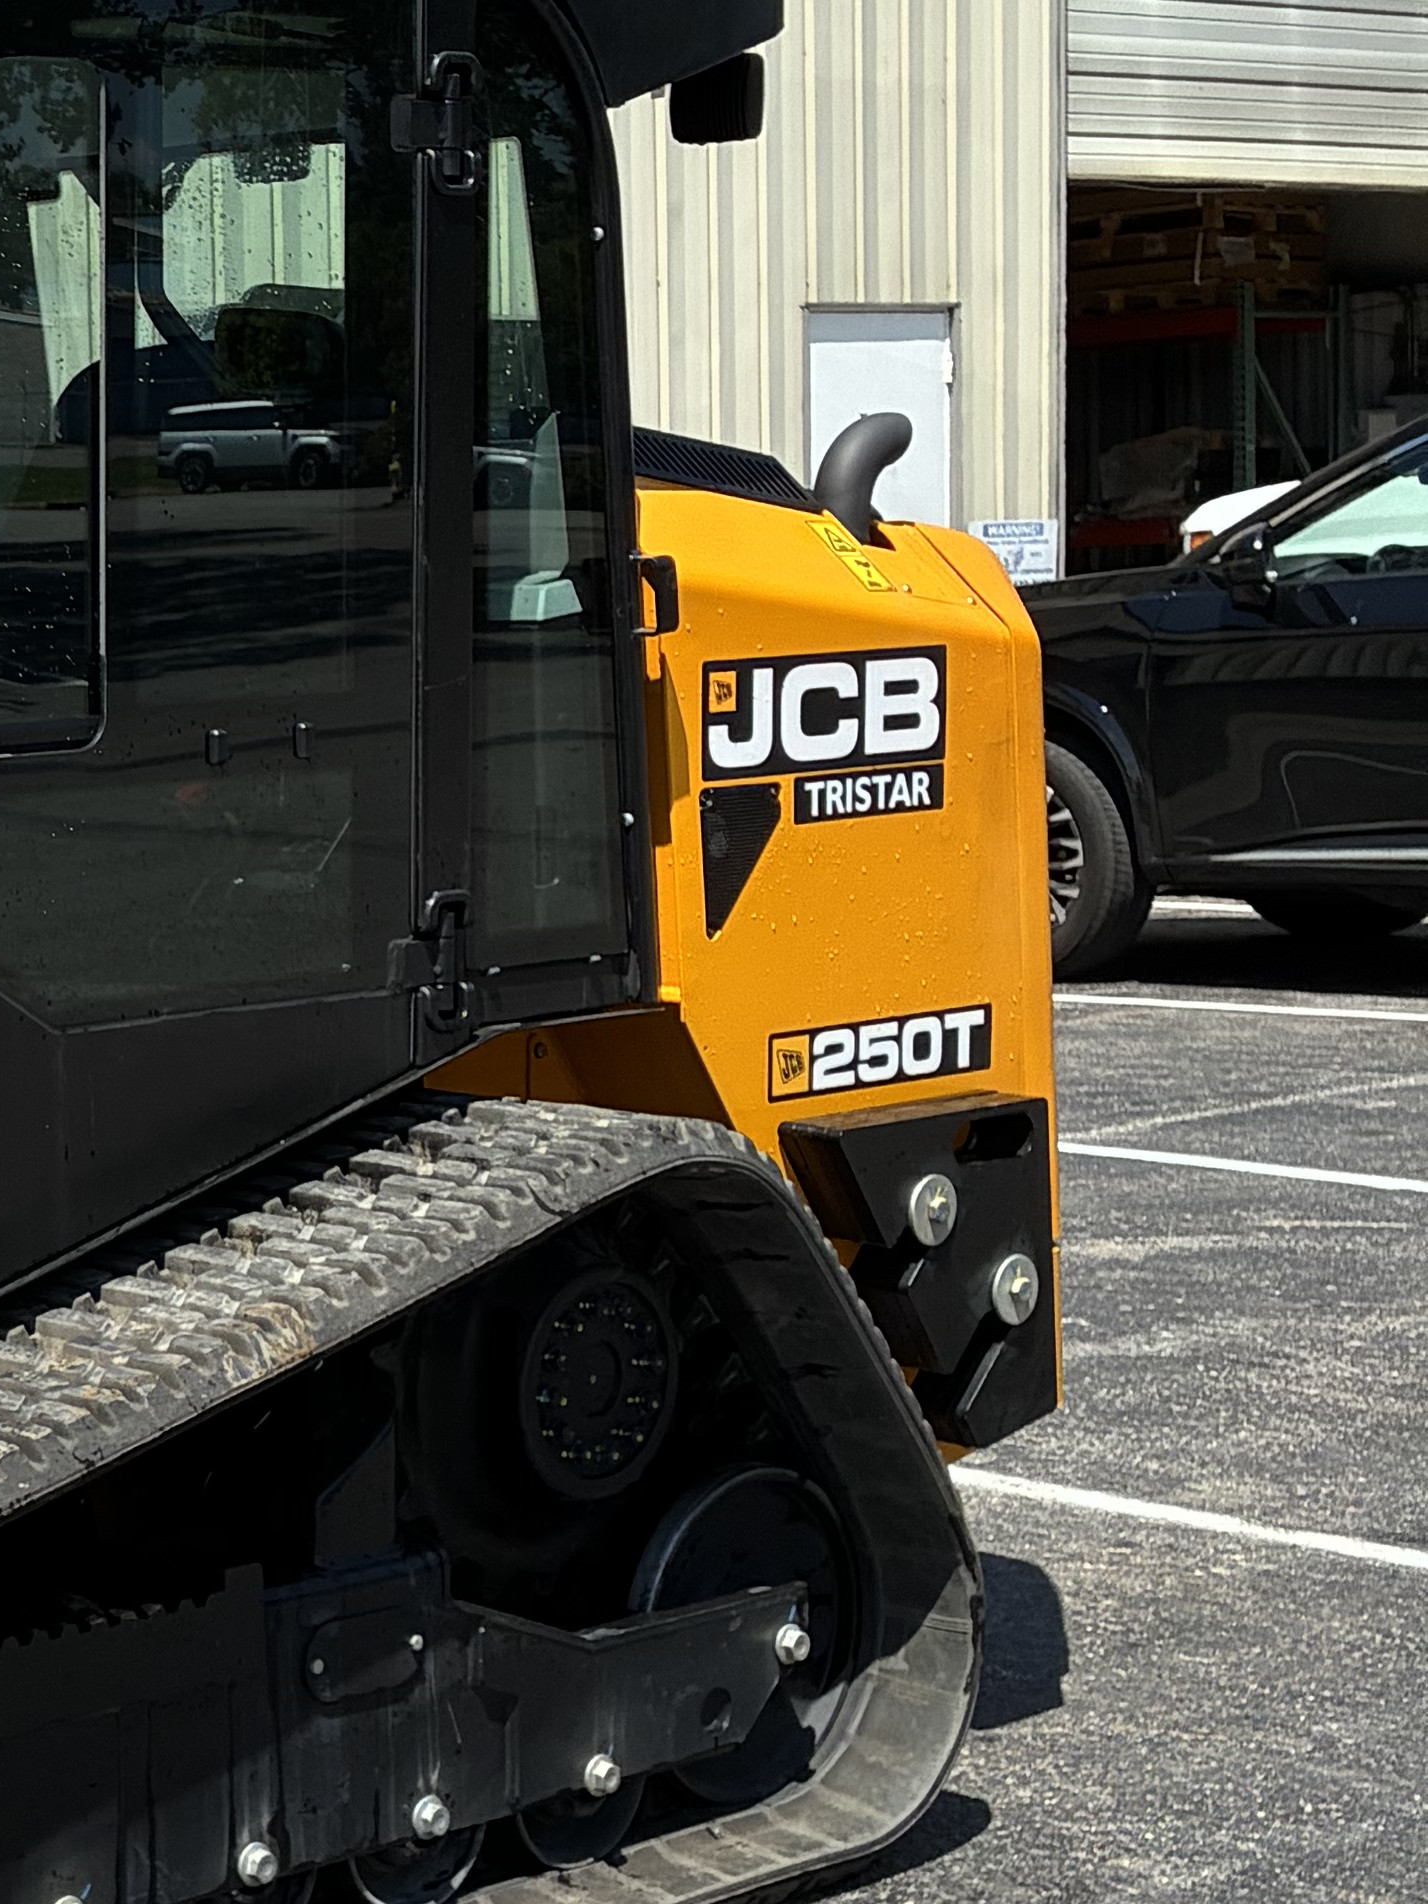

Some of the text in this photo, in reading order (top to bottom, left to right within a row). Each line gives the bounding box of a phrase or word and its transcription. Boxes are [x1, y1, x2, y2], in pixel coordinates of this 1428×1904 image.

[708, 656, 940, 769] JCB
[804, 771, 931, 817] TRISTAR
[812, 1009, 985, 1091] 250T
